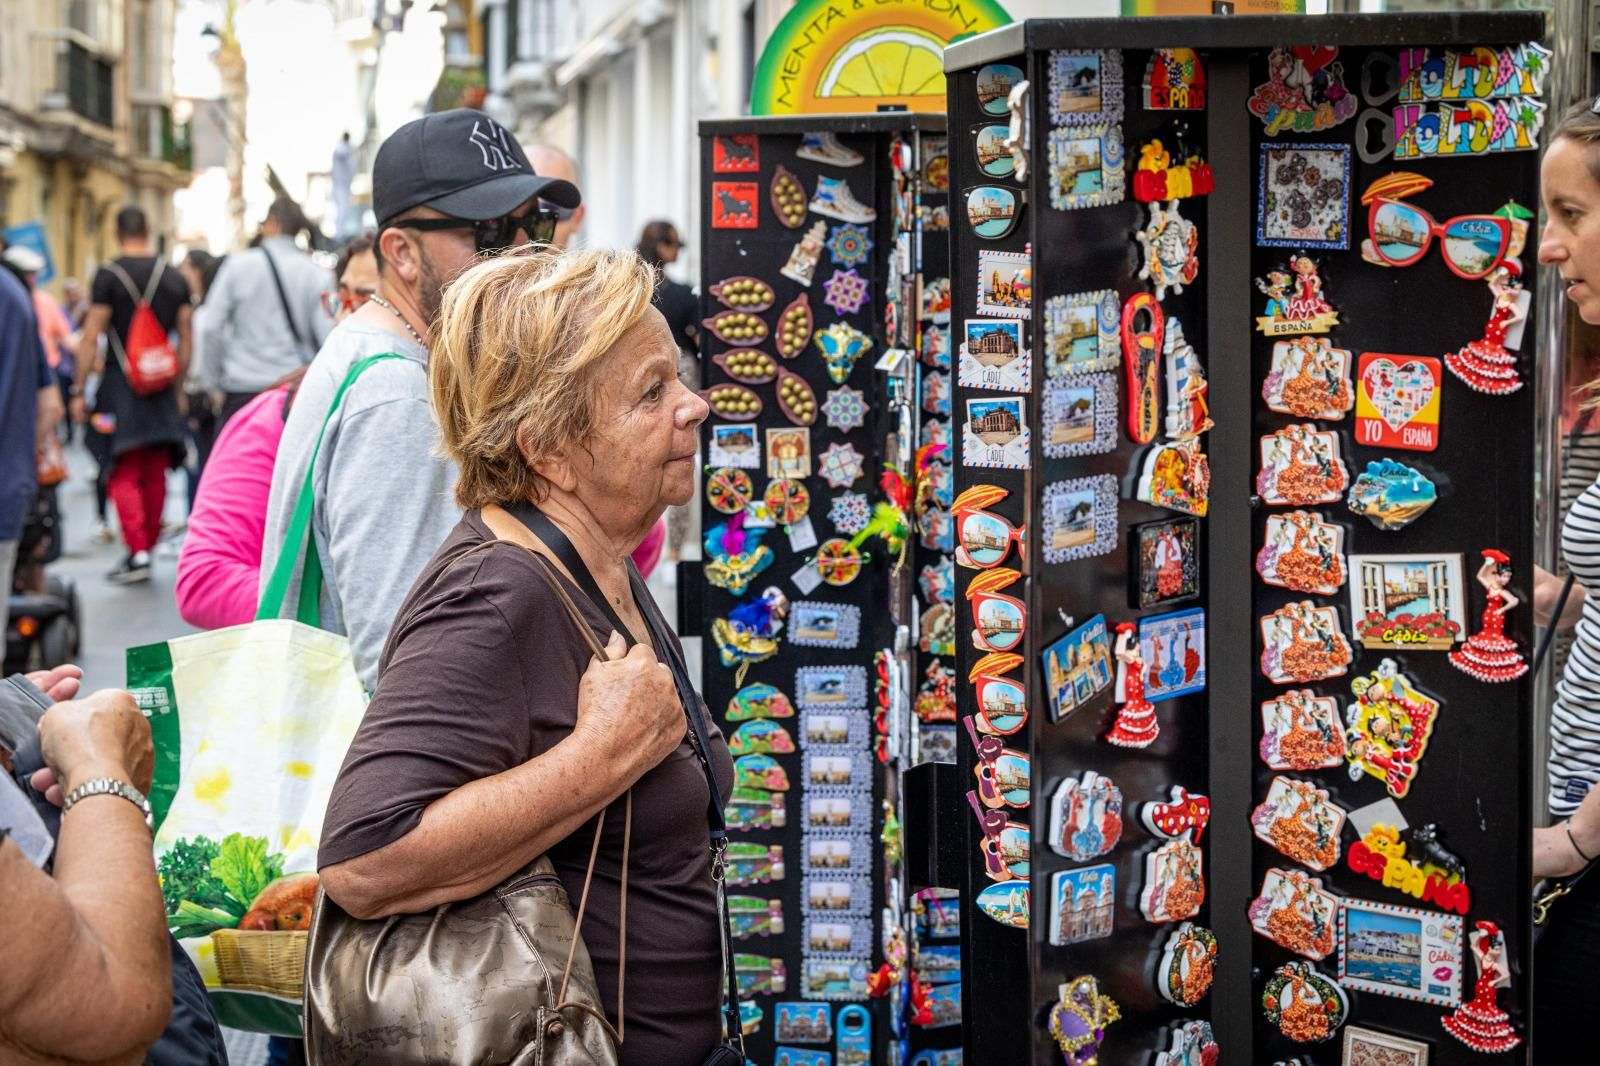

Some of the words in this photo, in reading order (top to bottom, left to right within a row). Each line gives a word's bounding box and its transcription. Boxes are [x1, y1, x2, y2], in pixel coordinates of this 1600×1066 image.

[777, 6, 847, 108] MENTA
[1399, 43, 1550, 101] HOLIDAY
[1393, 97, 1544, 158] HOLIDAY
[1274, 320, 1313, 333] ESPAÑA
[986, 447, 1005, 463] CÁDIZ
[1363, 418, 1383, 443] YO
[1402, 426, 1433, 448] ESPAÑA
